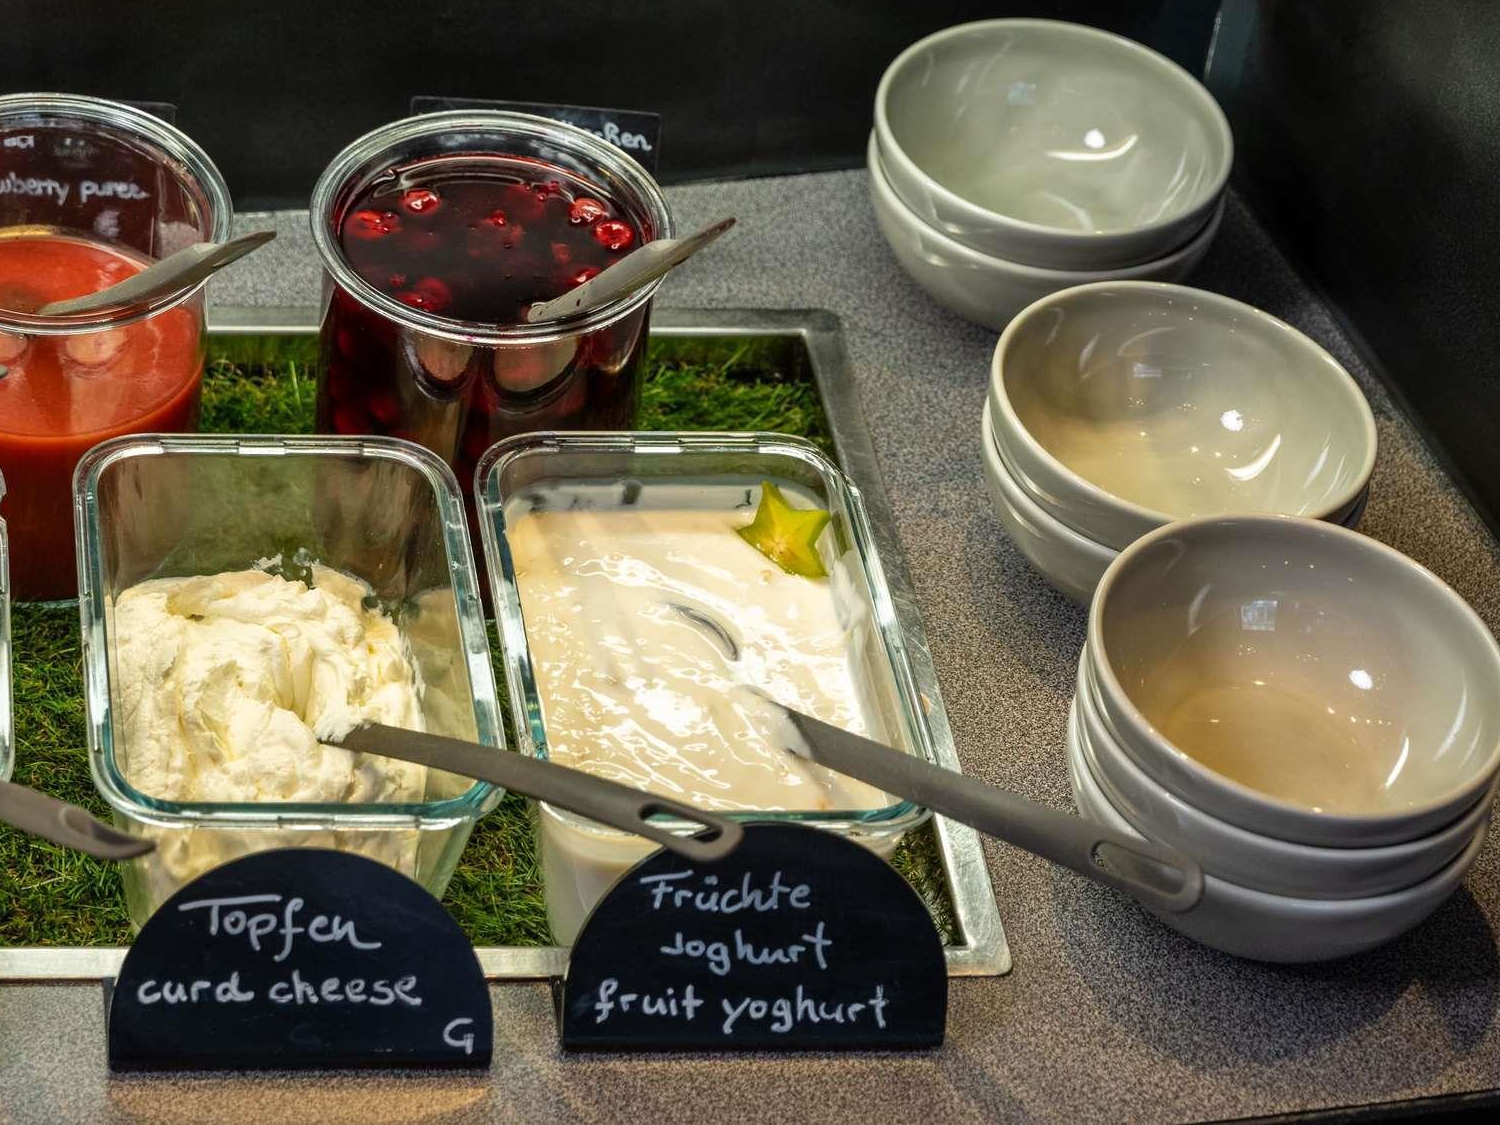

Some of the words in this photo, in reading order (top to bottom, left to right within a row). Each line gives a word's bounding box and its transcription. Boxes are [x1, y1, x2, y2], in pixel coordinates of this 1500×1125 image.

[640, 870, 811, 912] Früchte
[179, 895, 382, 958] Topfen
[138, 972, 254, 1004] curd
[269, 972, 422, 1005] cheese
[595, 980, 704, 1023] fruit
[722, 985, 890, 1034] yoghurt
